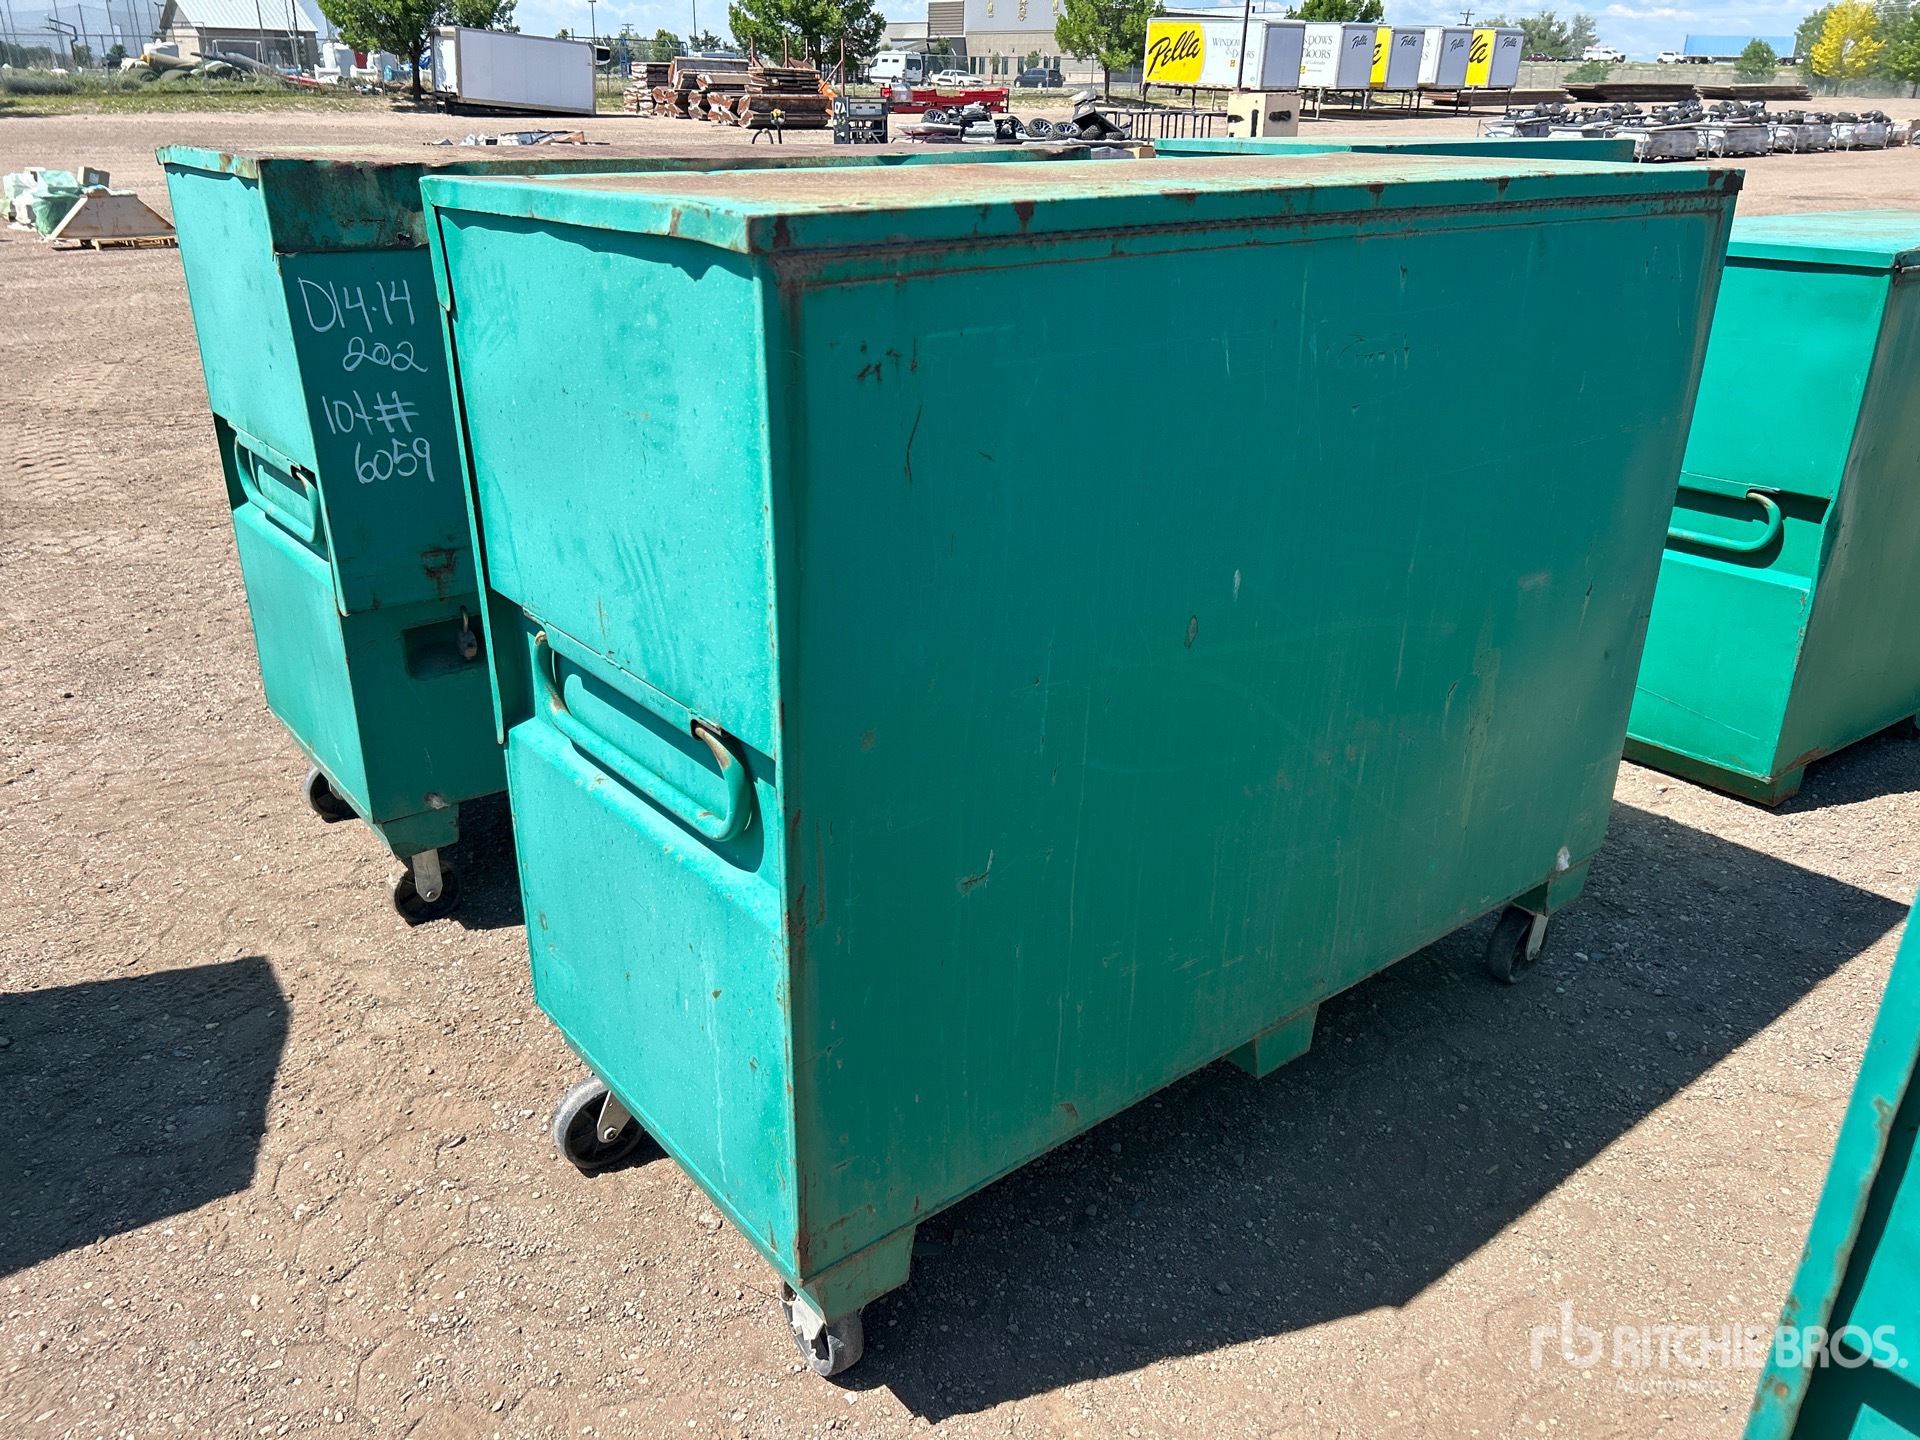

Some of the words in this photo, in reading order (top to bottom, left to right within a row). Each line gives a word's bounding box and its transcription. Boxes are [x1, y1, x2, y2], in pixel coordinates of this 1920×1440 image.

[1147, 30, 1200, 77] Pella
[1351, 34, 1368, 50] Pella
[342, 336, 428, 372] 202
[354, 437, 436, 485] 6059
